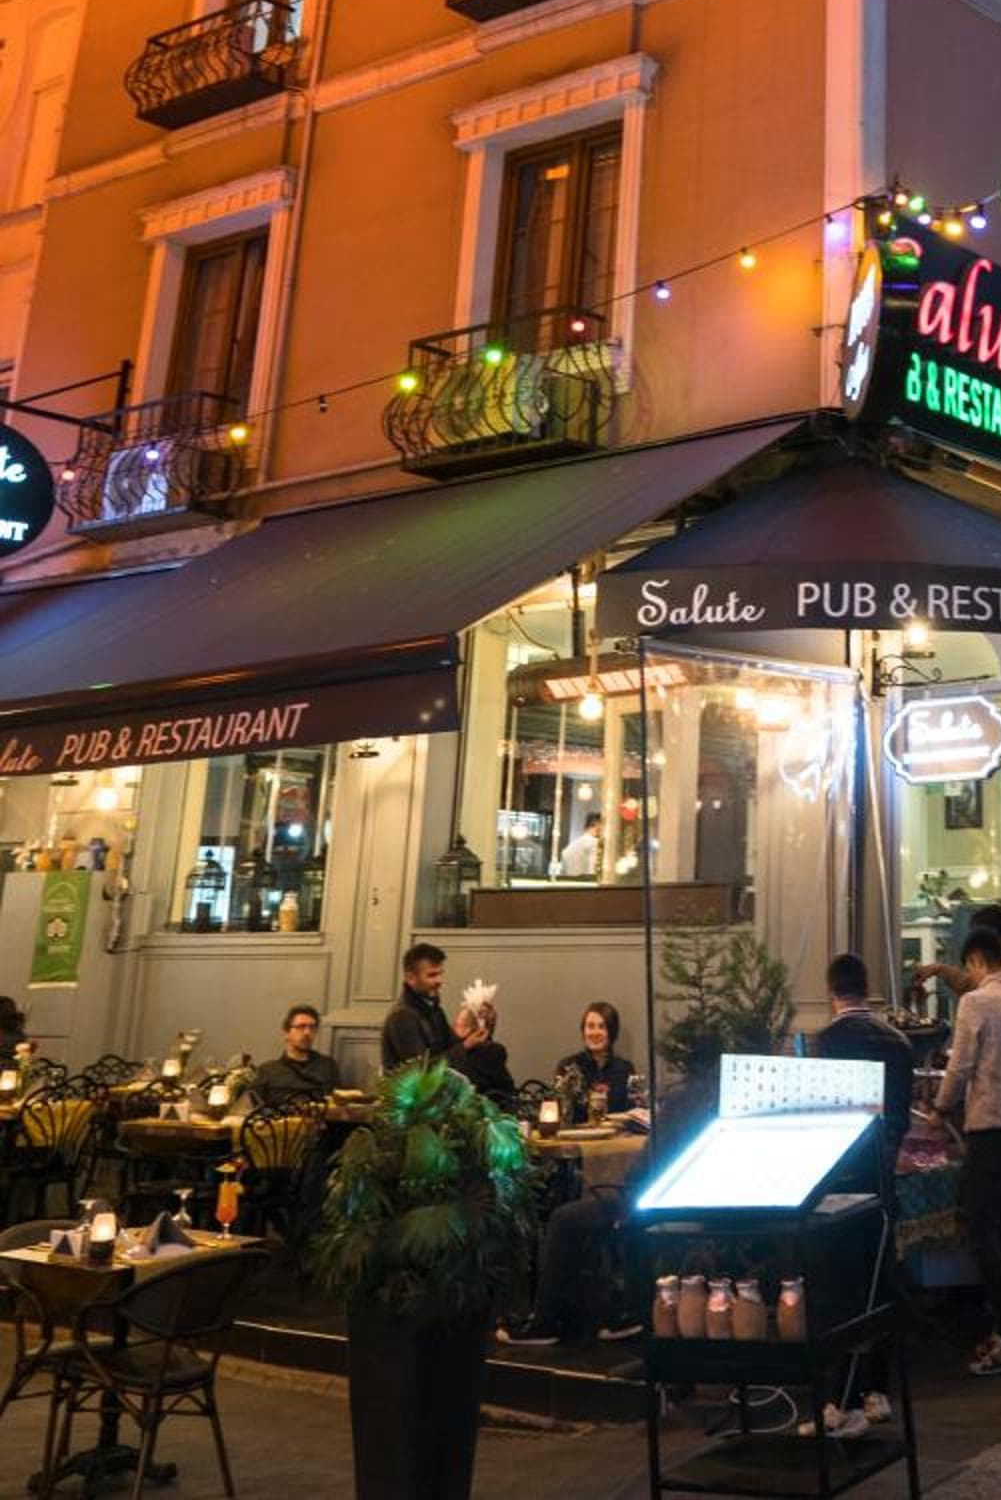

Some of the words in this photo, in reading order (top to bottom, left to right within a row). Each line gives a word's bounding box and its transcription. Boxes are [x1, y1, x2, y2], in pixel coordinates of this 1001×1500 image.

[926, 361, 941, 411] &
[637, 579, 765, 626] Salute
[797, 582, 876, 618] PUB
[889, 583, 917, 619] &
[56, 729, 112, 766] PUB
[111, 727, 133, 760] &
[135, 703, 309, 758] RESTAURANT
